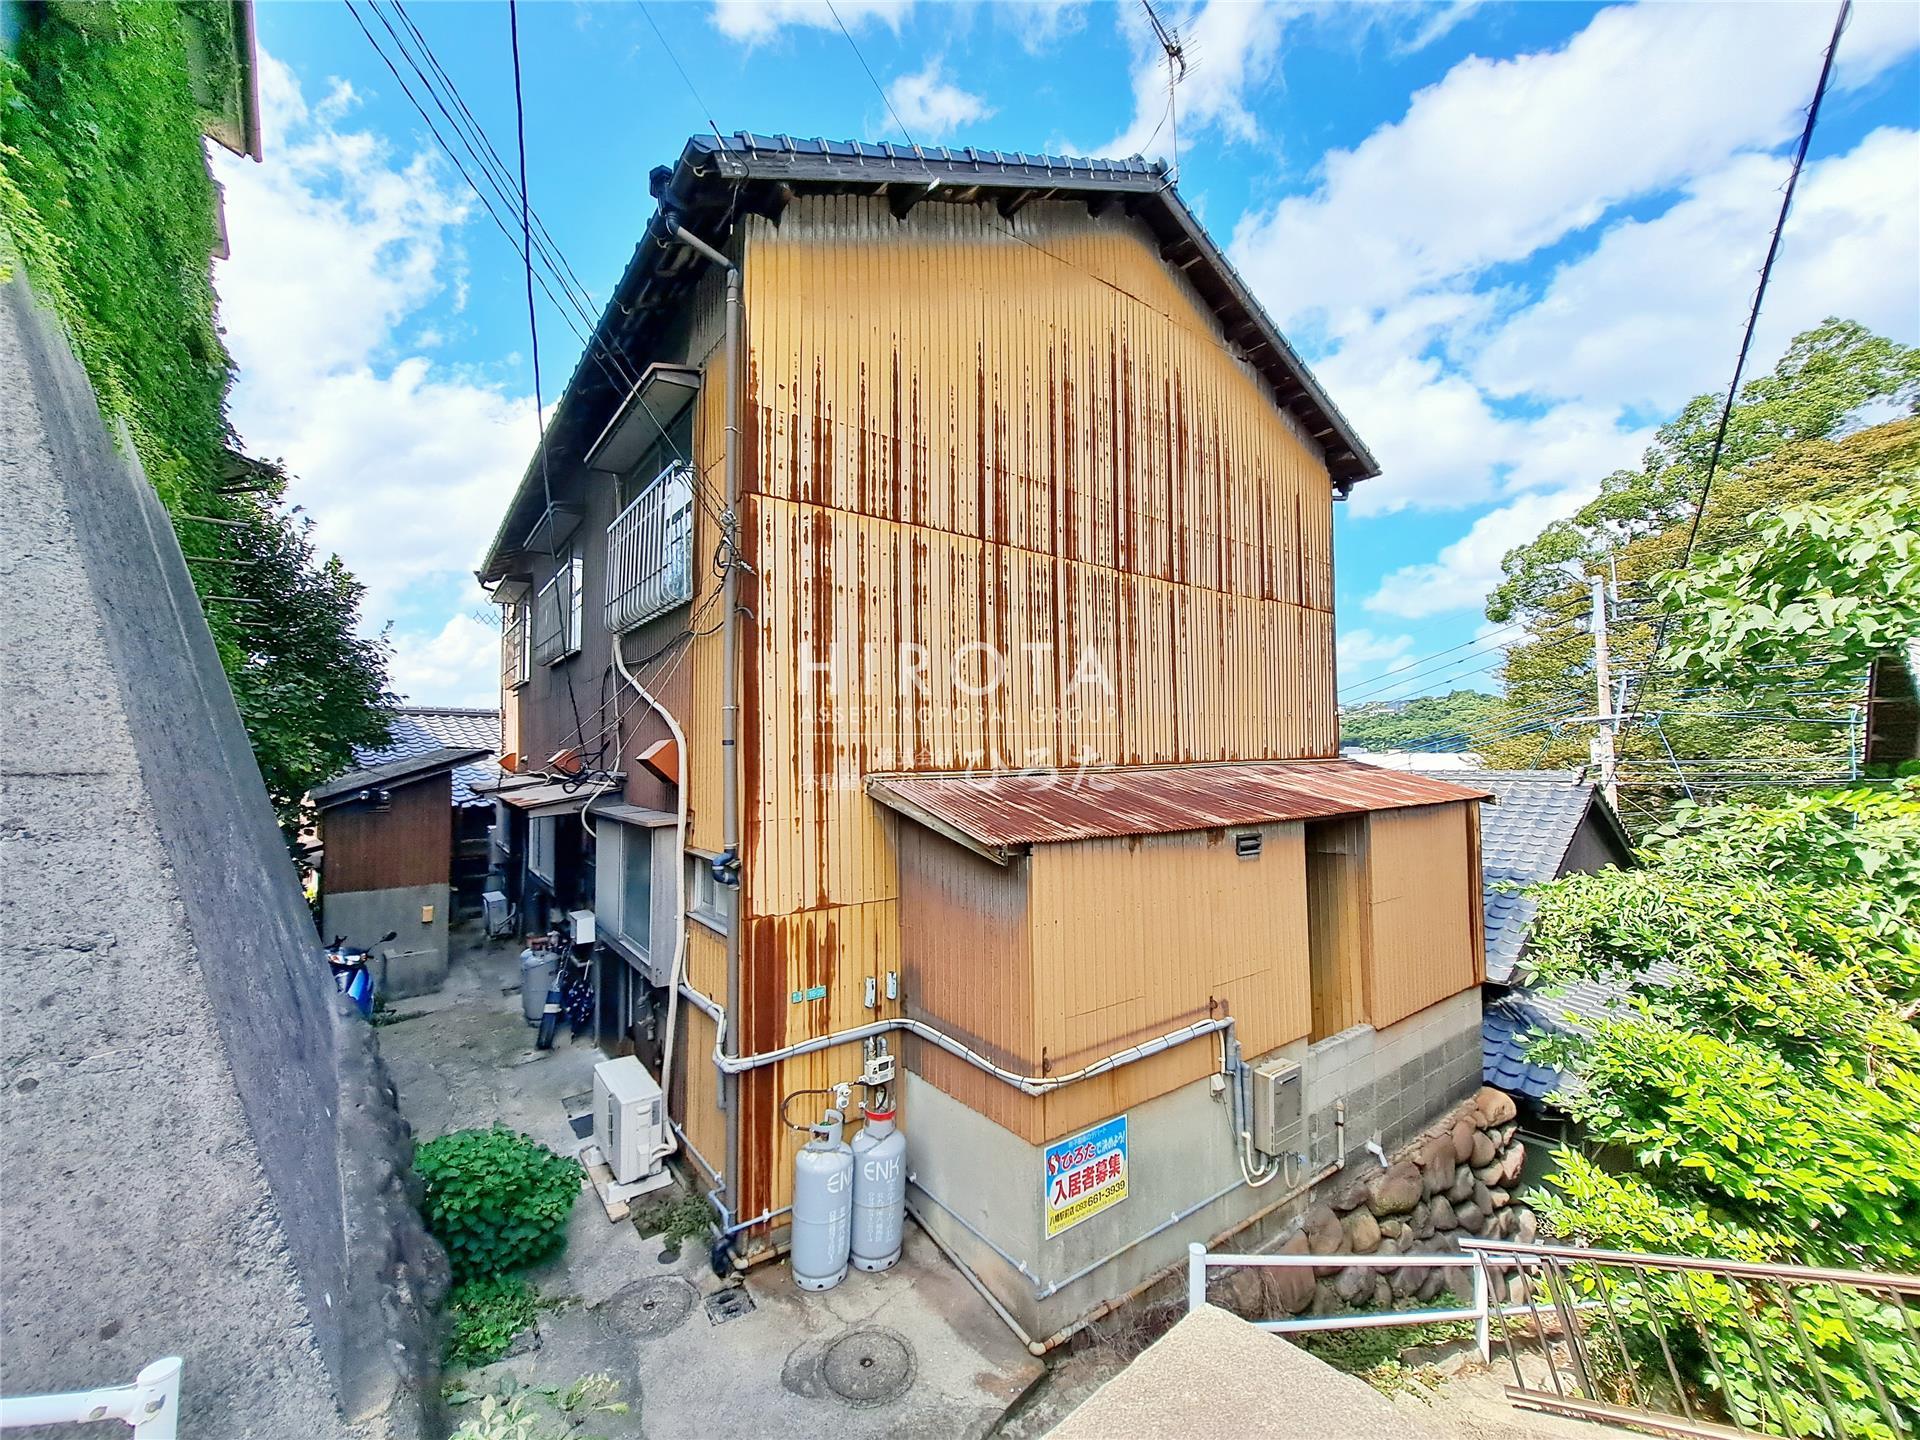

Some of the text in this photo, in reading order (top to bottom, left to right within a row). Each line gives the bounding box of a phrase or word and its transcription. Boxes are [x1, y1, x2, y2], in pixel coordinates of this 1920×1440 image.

[827, 1165, 853, 1194] EN
[864, 1155, 900, 1181] ENK
[1054, 1153, 1121, 1206] 入居者募集
[1087, 1180, 1125, 1207] 661-3939
